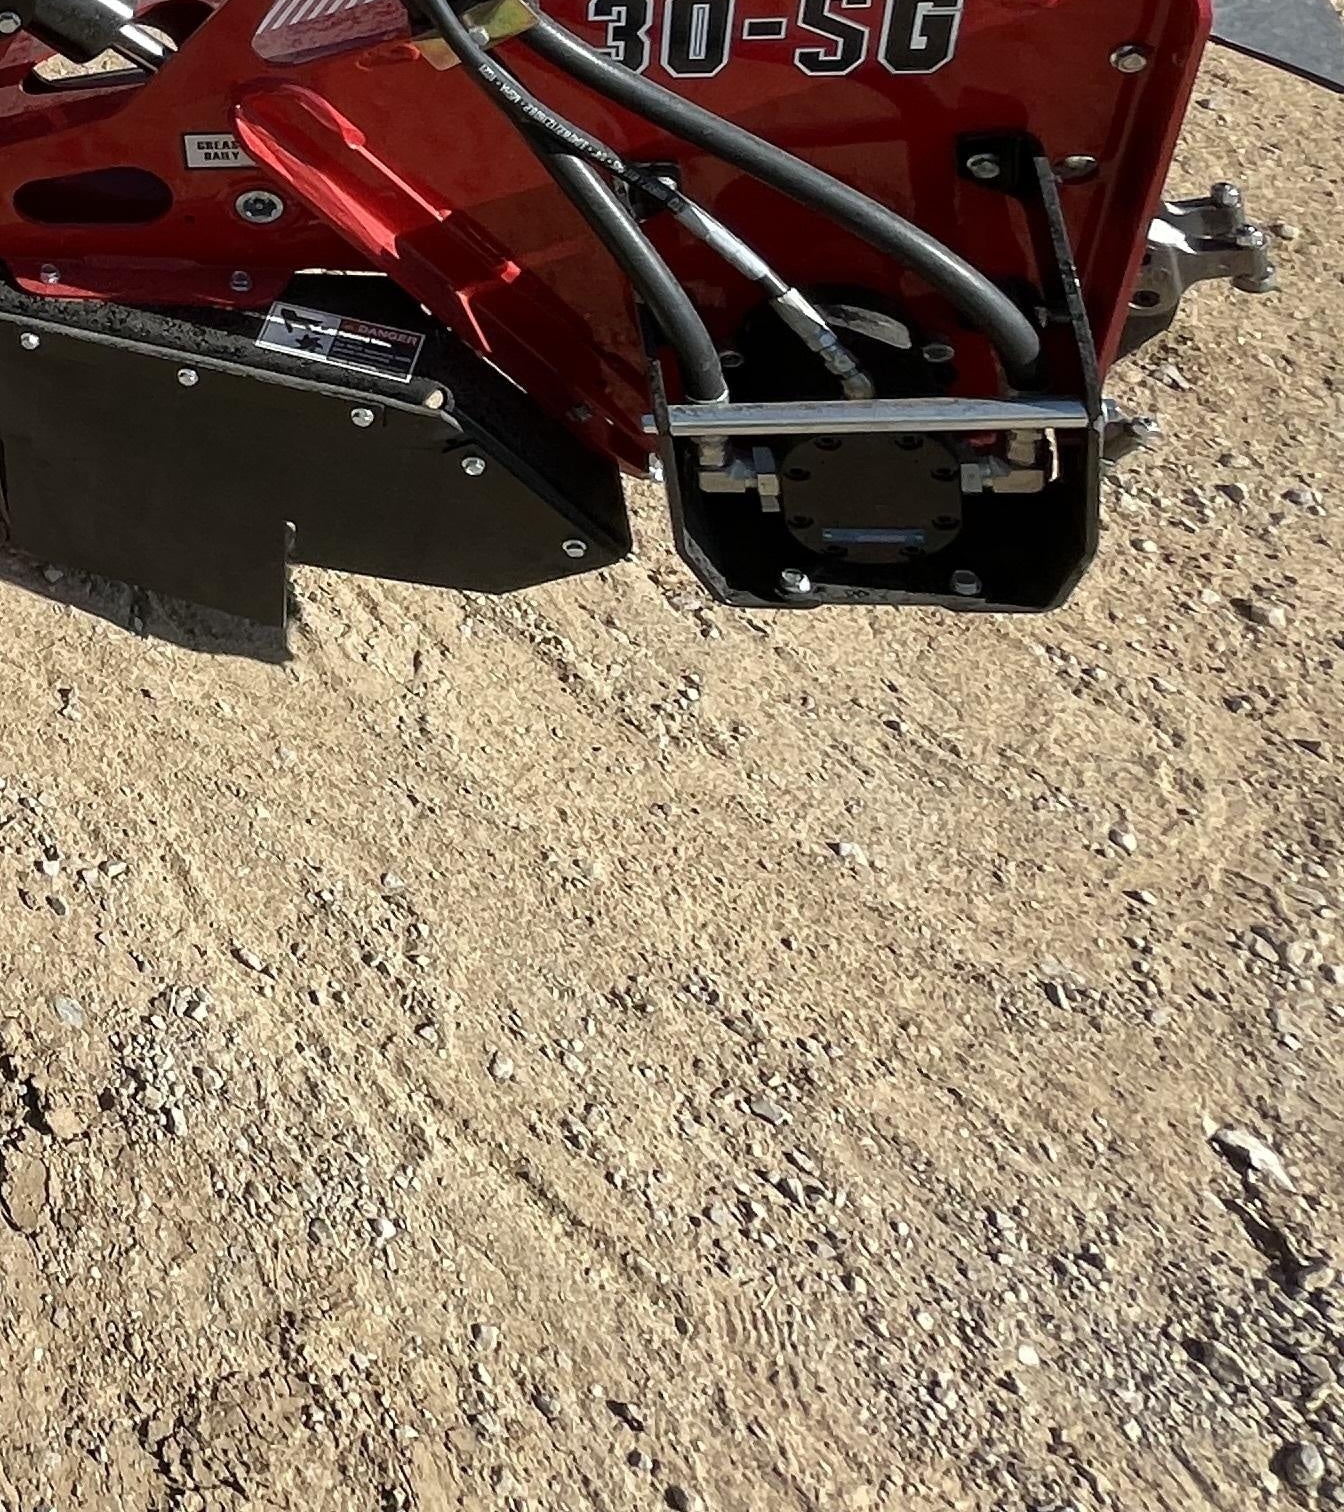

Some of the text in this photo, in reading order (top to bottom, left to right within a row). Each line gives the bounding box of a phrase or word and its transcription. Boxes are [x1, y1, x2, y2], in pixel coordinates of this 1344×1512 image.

[196, 140, 240, 150] GREAS
[203, 151, 240, 161] DAILY
[357, 324, 418, 346] DANGER
